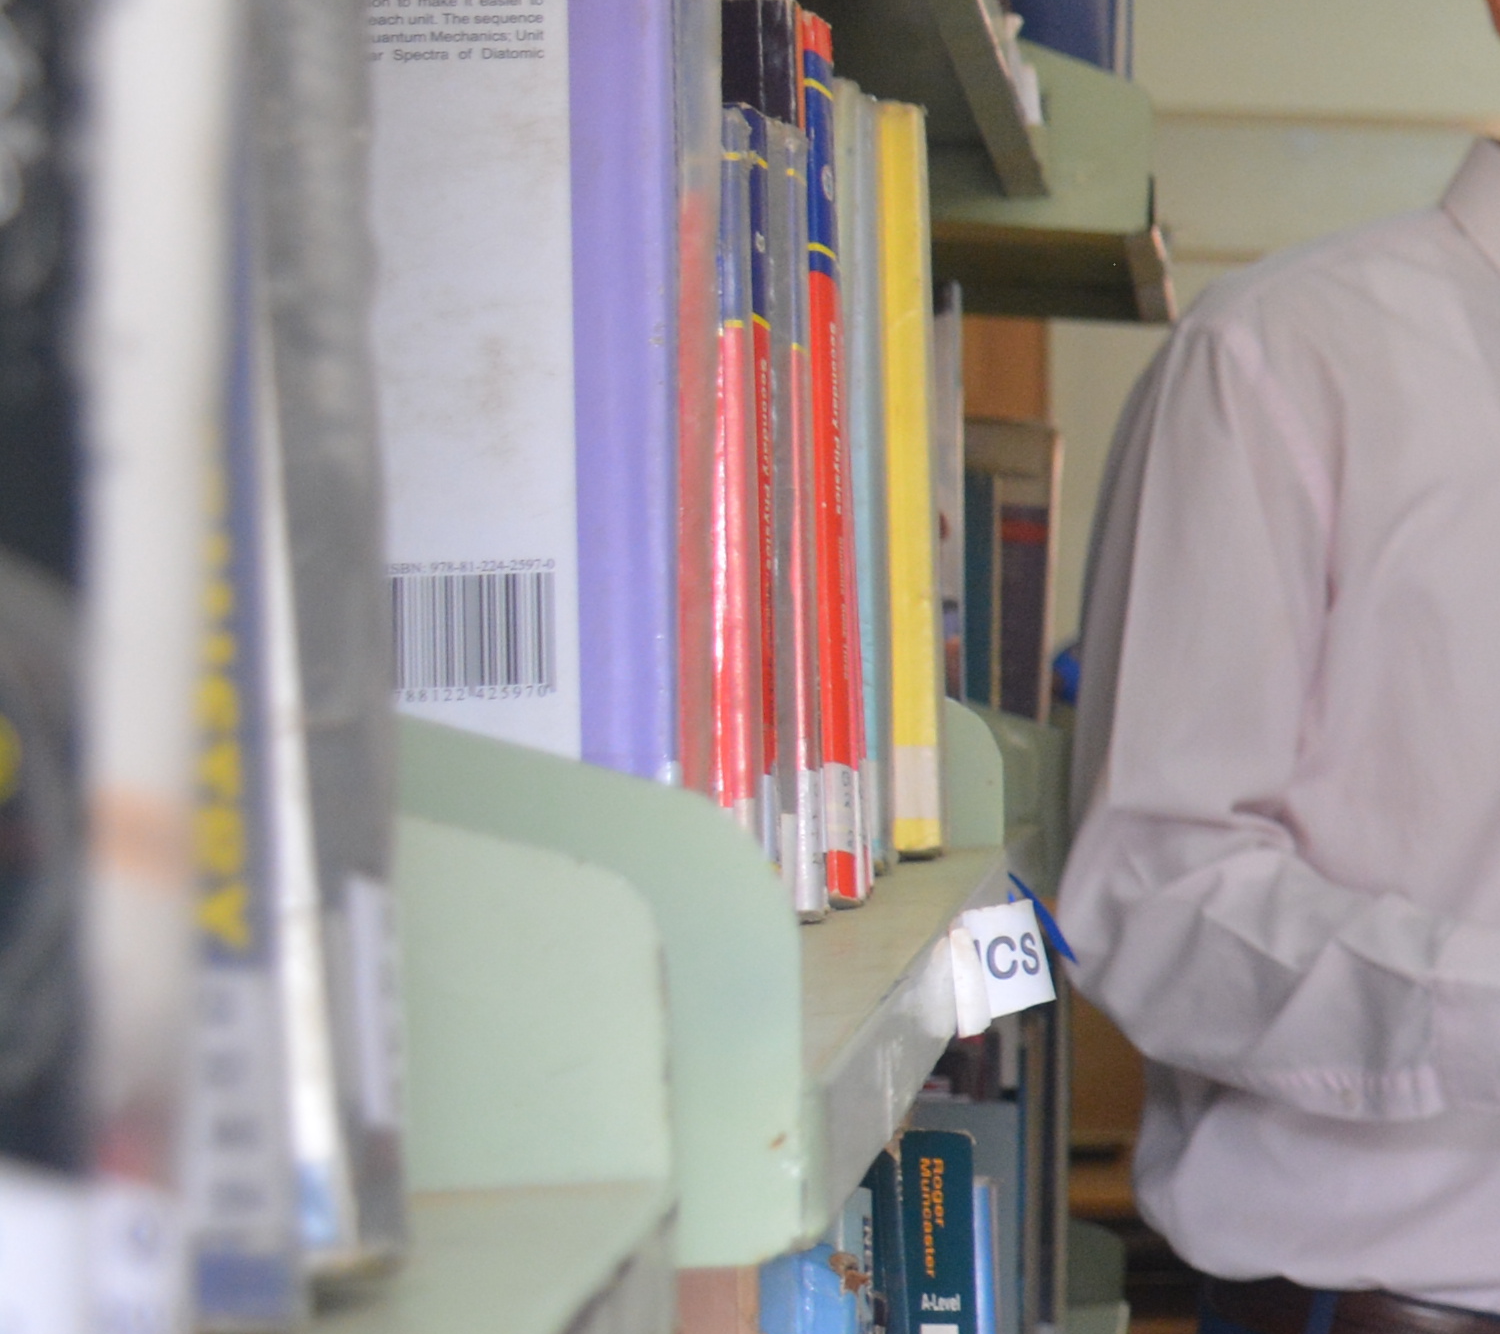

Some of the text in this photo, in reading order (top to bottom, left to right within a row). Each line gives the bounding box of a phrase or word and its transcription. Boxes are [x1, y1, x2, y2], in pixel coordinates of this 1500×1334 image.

[393, 48, 544, 63] Spectra of Diatomic
[829, 321, 843, 516] Secondary Physics
[919, 1157, 936, 1279] Muncaster
[931, 1157, 945, 1229] Roger
[921, 1292, 962, 1312] A-Level
